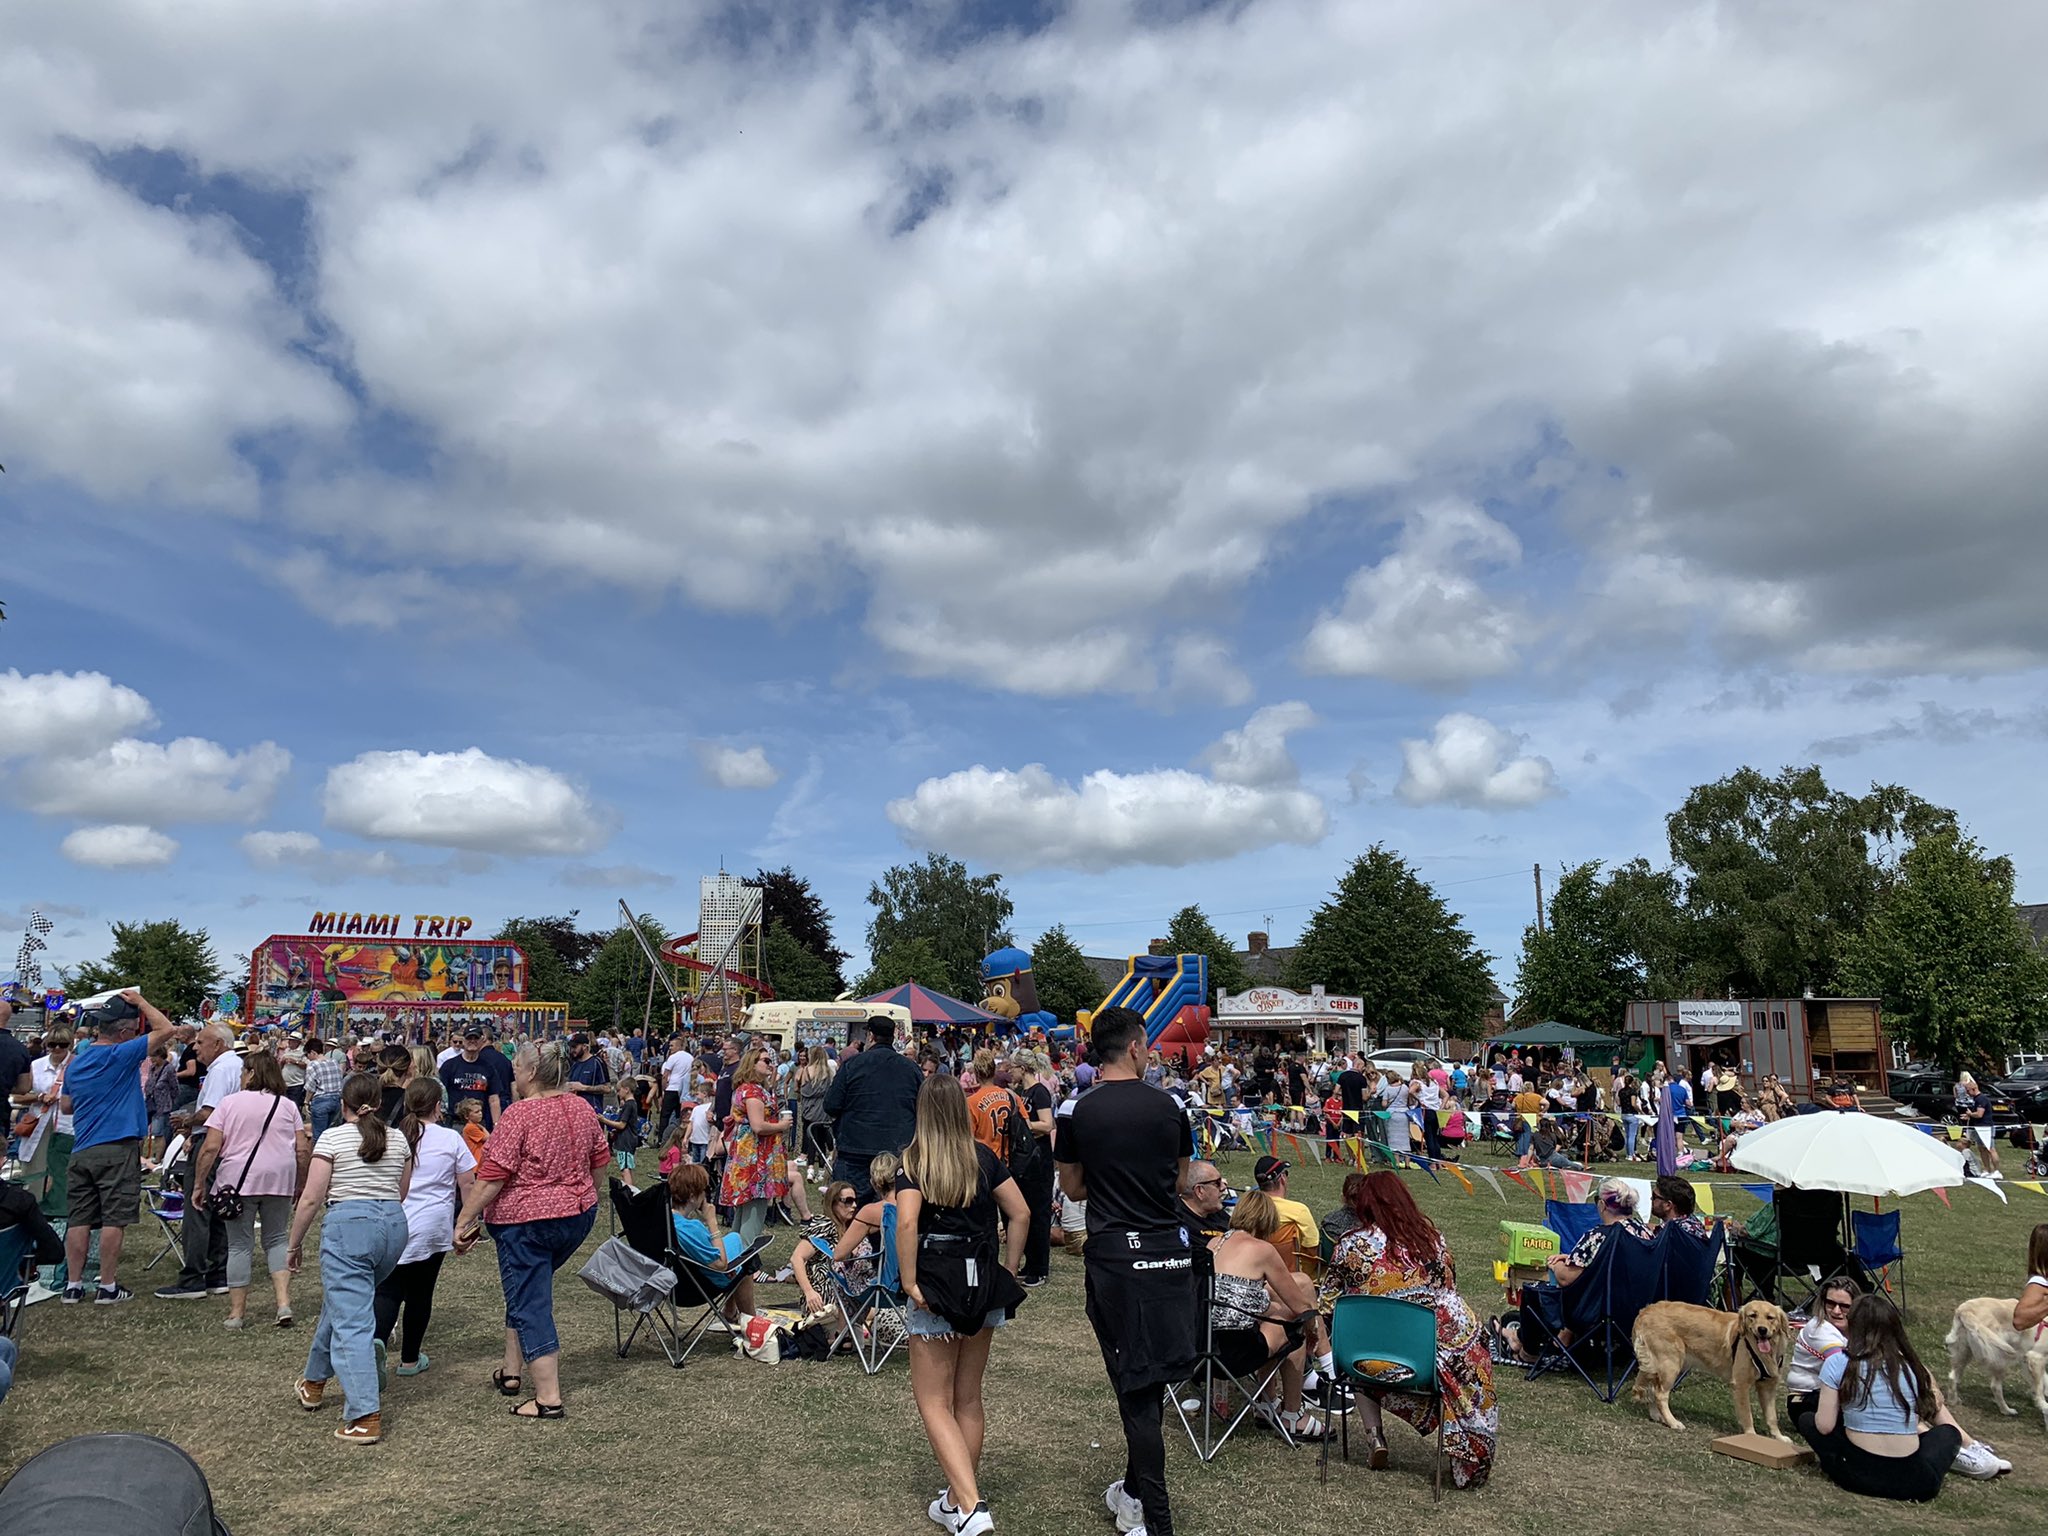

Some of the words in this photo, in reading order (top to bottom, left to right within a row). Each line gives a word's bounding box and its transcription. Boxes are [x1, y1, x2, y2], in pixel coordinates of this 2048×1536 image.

[308, 911, 399, 936] MIAMI
[413, 914, 472, 938] TRIP
[1330, 1000, 1359, 1010] CHIPS
[1128, 1240, 1141, 1249] LD
